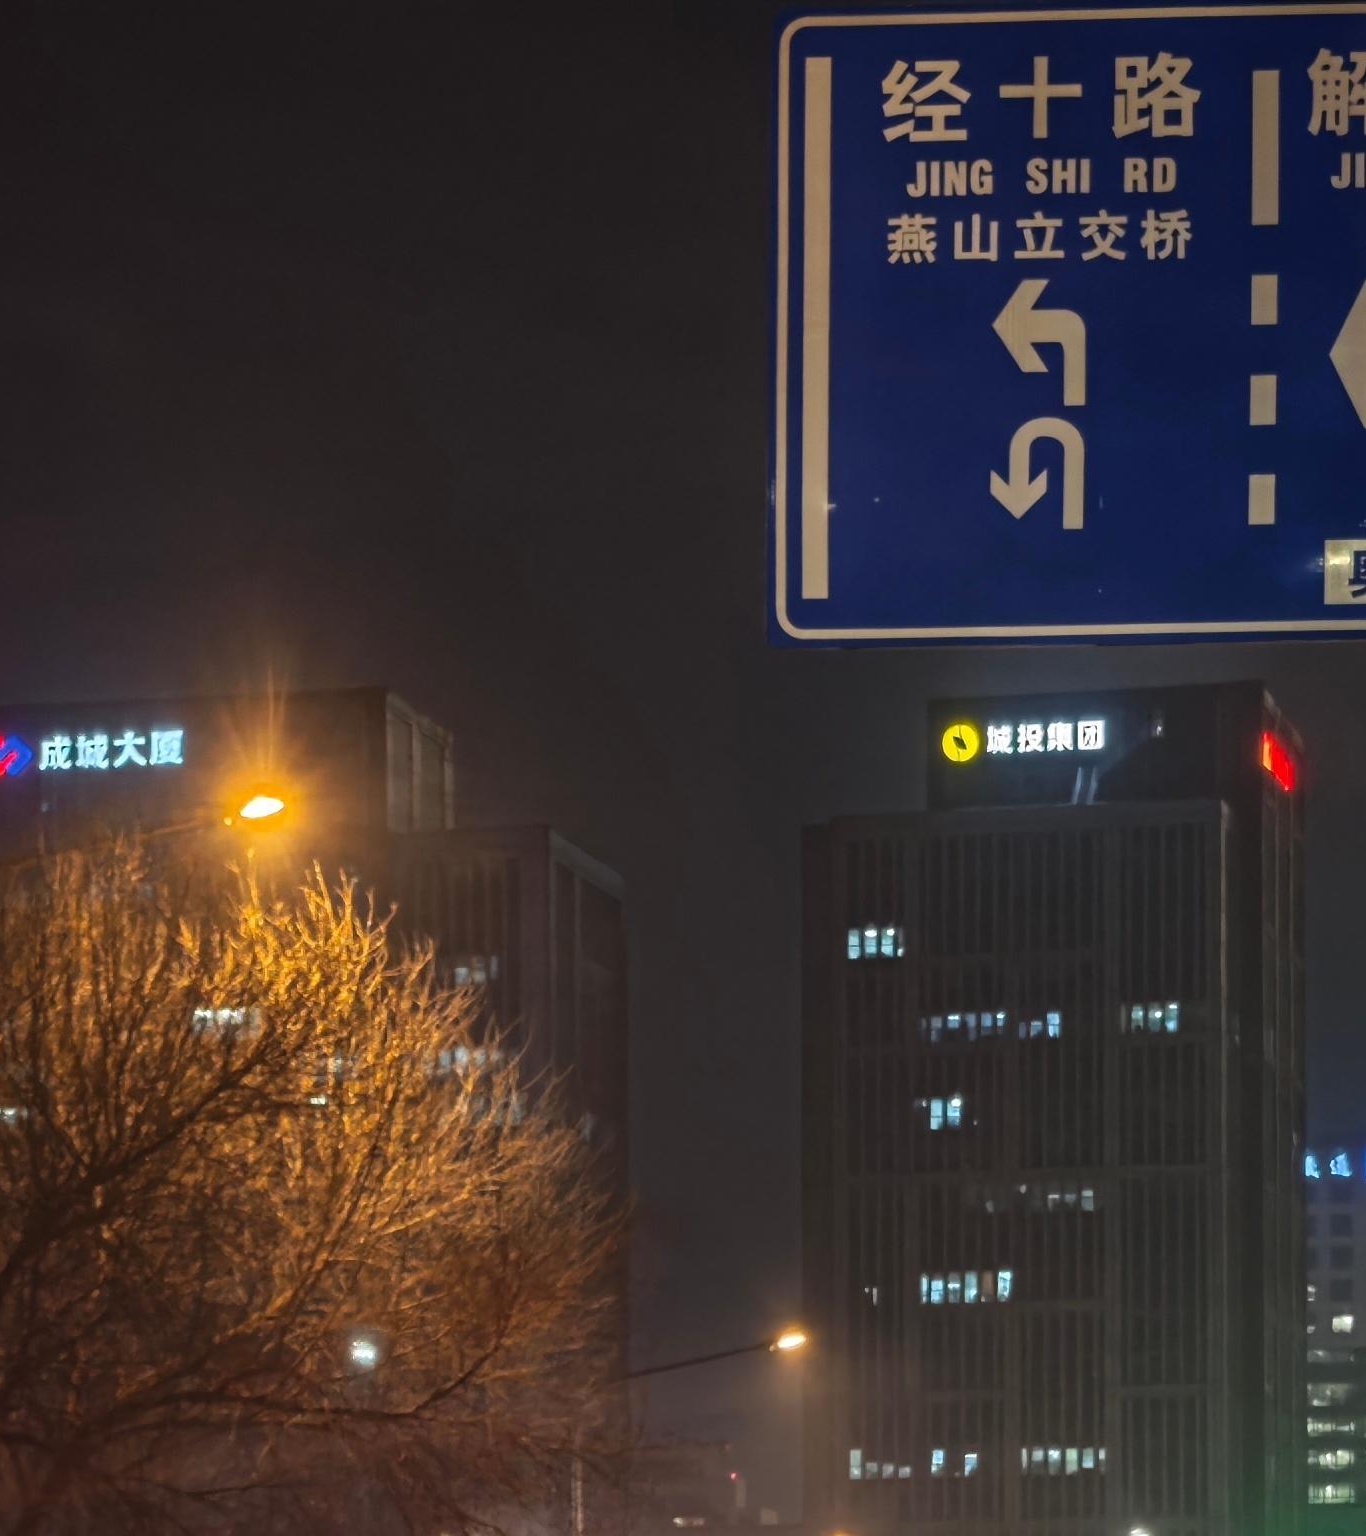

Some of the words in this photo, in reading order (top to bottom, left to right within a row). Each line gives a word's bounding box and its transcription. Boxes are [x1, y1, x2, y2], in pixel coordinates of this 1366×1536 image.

[882, 52, 1201, 143] 经十路
[906, 158, 993, 197] JING
[1026, 157, 1091, 194] SHI
[1124, 156, 1176, 193] RD
[887, 209, 1193, 265] 燕山立交桥
[39, 729, 184, 771] 成城大厦
[986, 719, 1106, 755] 城投集团
